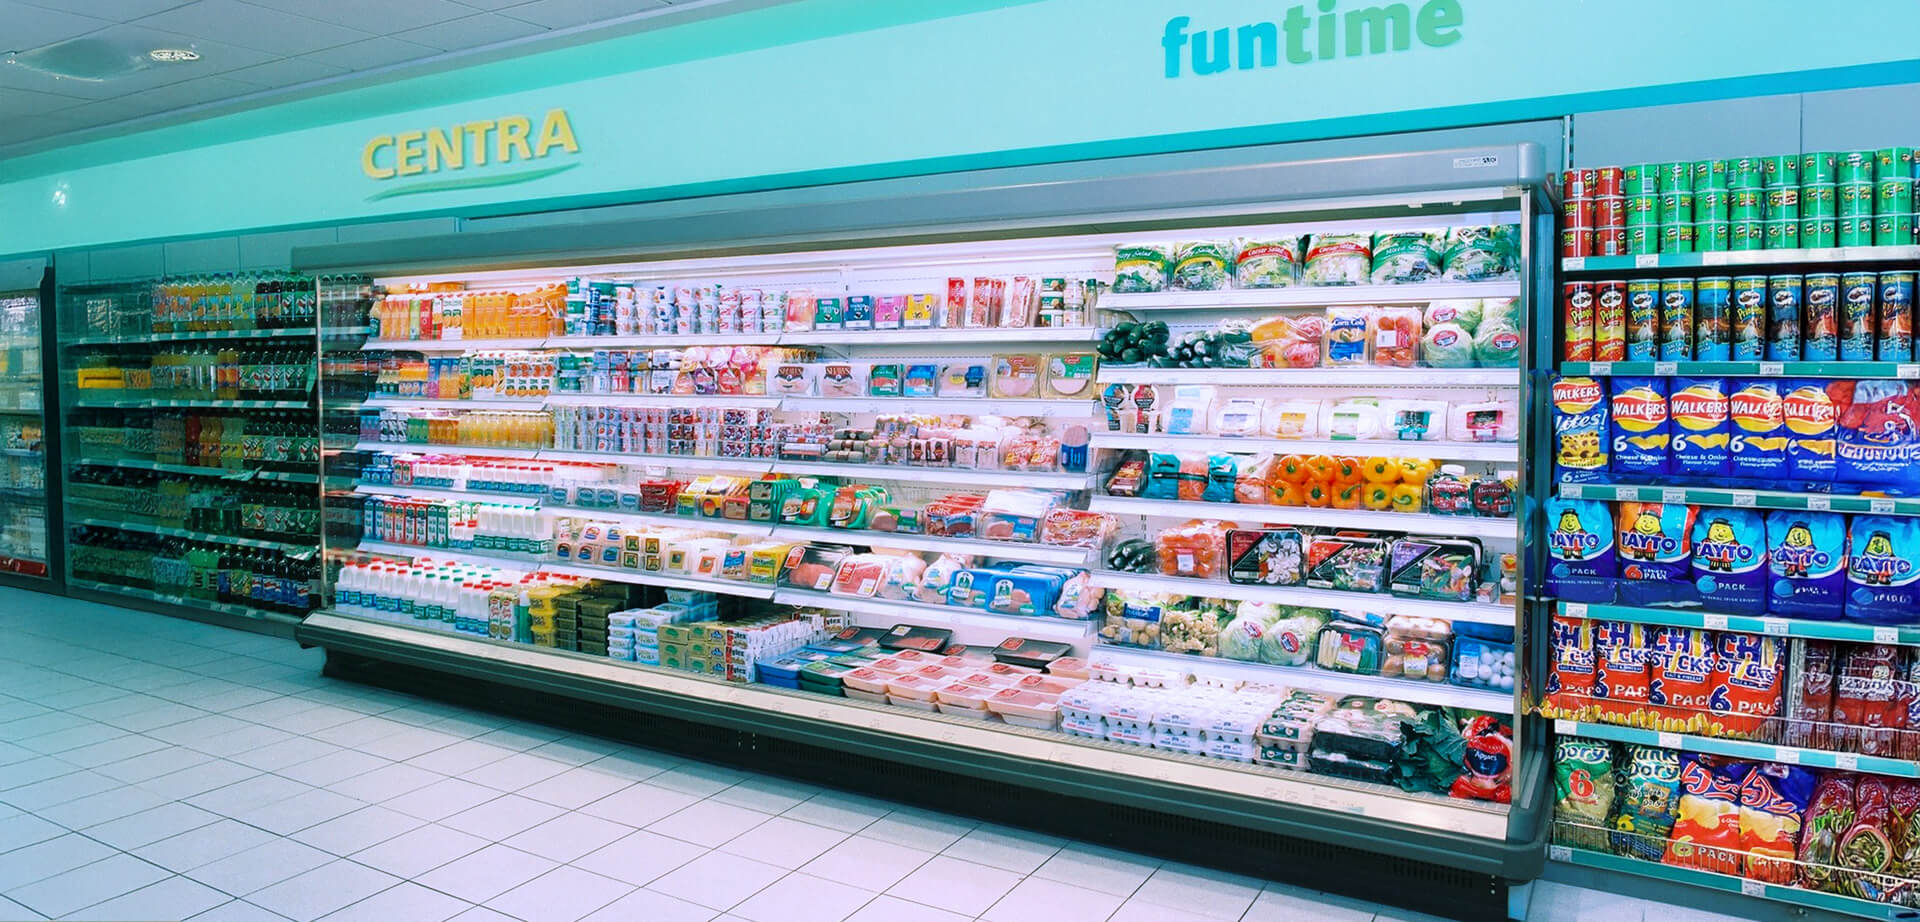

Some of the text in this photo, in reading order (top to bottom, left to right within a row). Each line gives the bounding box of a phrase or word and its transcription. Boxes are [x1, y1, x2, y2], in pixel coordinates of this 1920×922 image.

[1161, 0, 1464, 79] funtime
[361, 108, 580, 180] CENTRA
[1553, 386, 1600, 401] WALKERS
[1612, 402, 1667, 416] WALKERS
[1672, 401, 1729, 414] WALKERS
[1555, 408, 1608, 435] lites!
[1614, 435, 1628, 452] 6
[1672, 434, 1687, 452] 6
[1730, 435, 1745, 453] 6
[1561, 471, 1573, 483] 6
[1550, 533, 1600, 549] TAYTO
[1621, 532, 1677, 551] TAYTO
[1692, 541, 1753, 562] TAYTO
[1624, 564, 1643, 580] 6
[1696, 575, 1746, 594] 6 PACK
[1650, 652, 1714, 675] STICKS
[1648, 679, 1668, 705] 6
[1709, 684, 1733, 717] 6
[1569, 769, 1595, 798] 6
[1697, 847, 1736, 865] PACK
